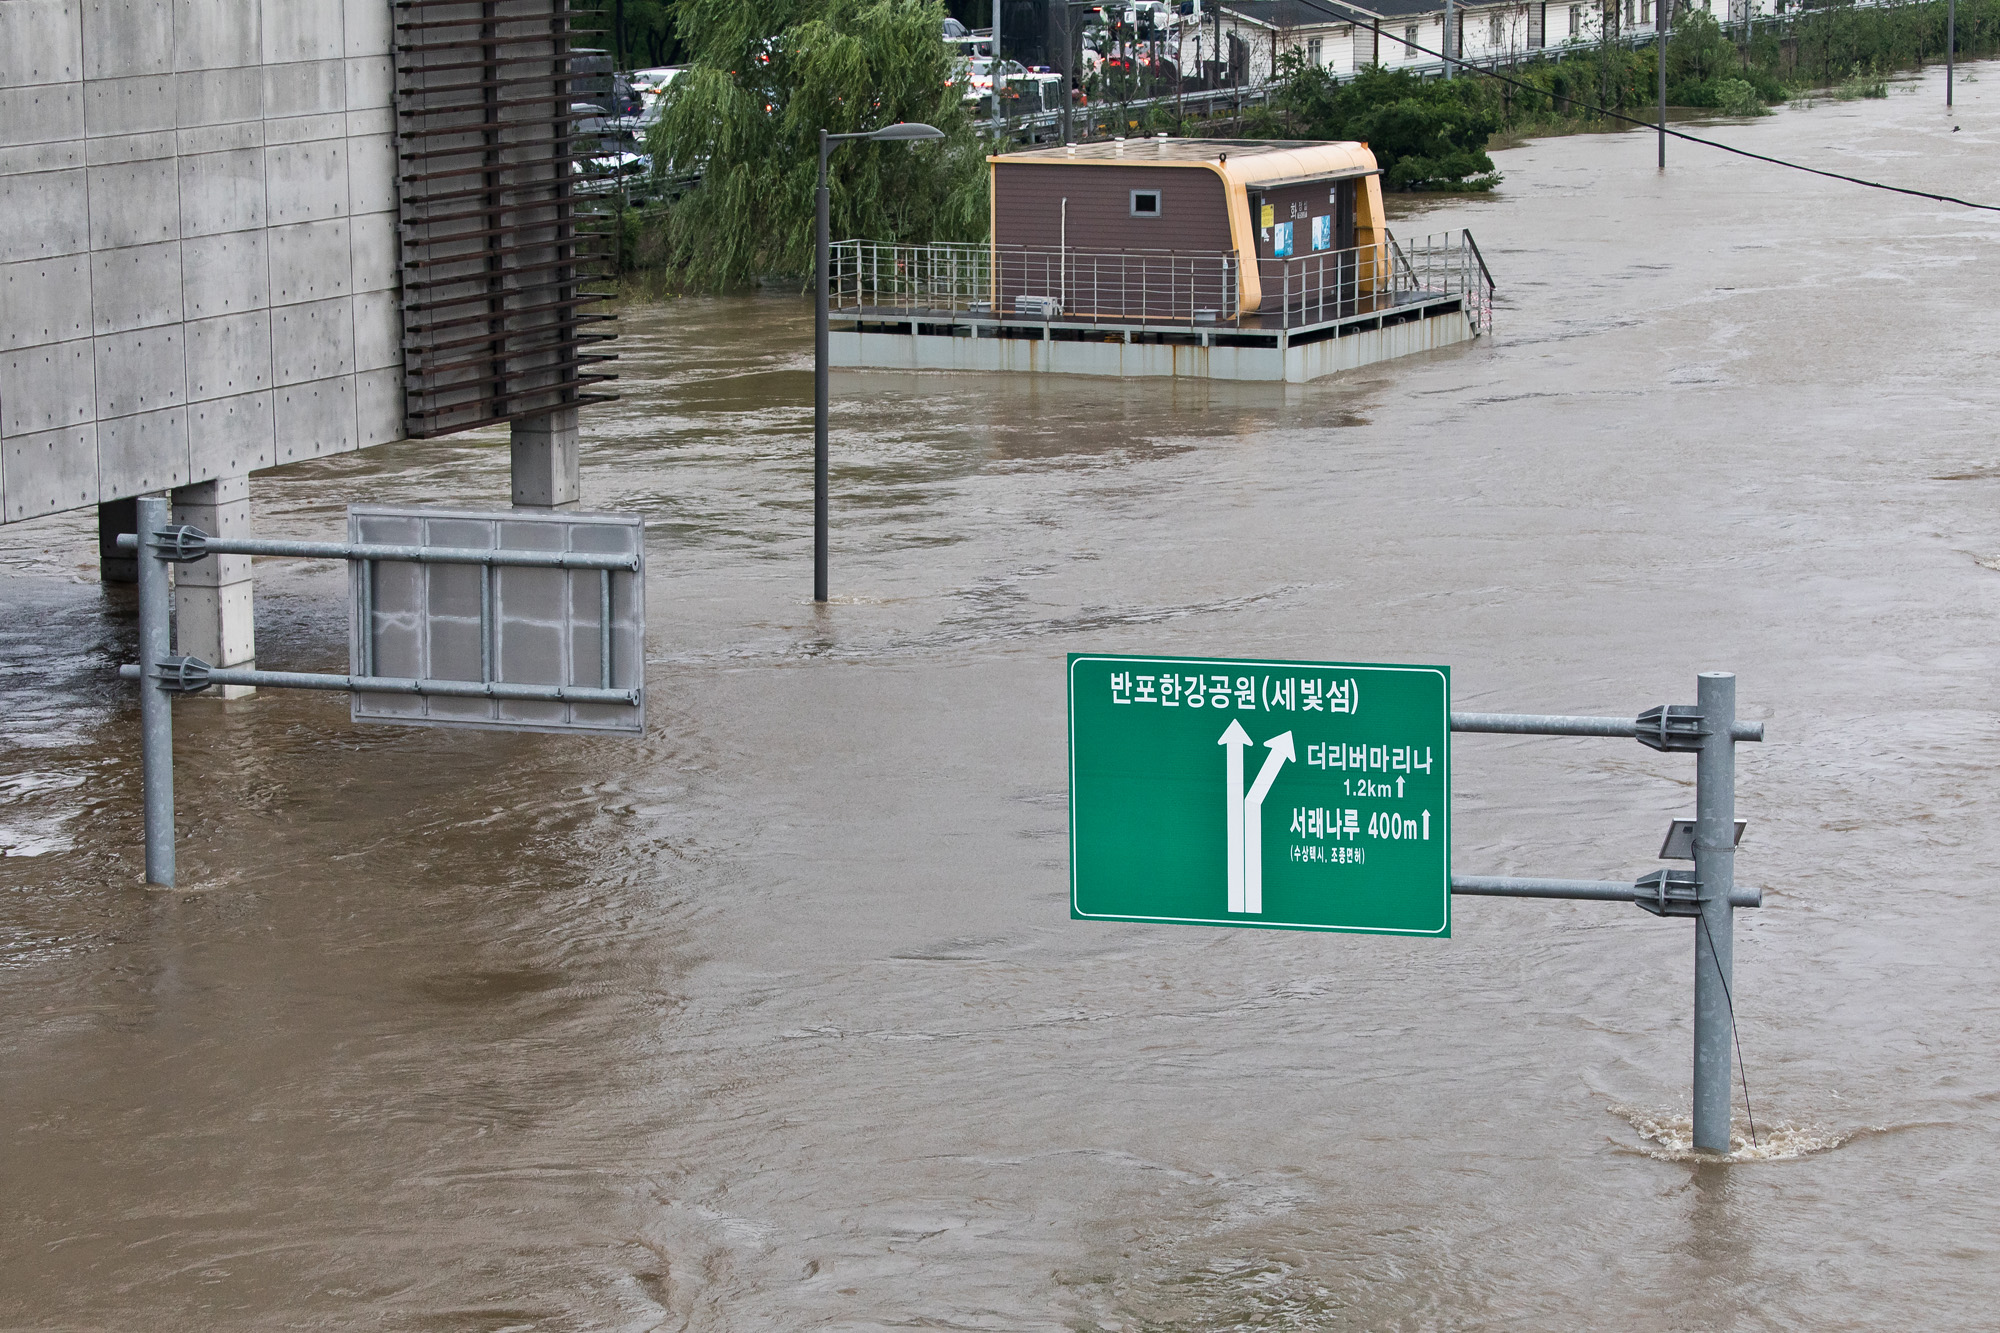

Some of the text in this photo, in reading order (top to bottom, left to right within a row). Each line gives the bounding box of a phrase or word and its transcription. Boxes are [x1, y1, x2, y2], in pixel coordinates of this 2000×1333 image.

[1307, 742, 1433, 775] 더리버마리나
[1343, 778, 1392, 798] 1.2km
[1289, 807, 1418, 841] 서래나루 400m
[1331, 847, 1365, 865] 조종면허)
